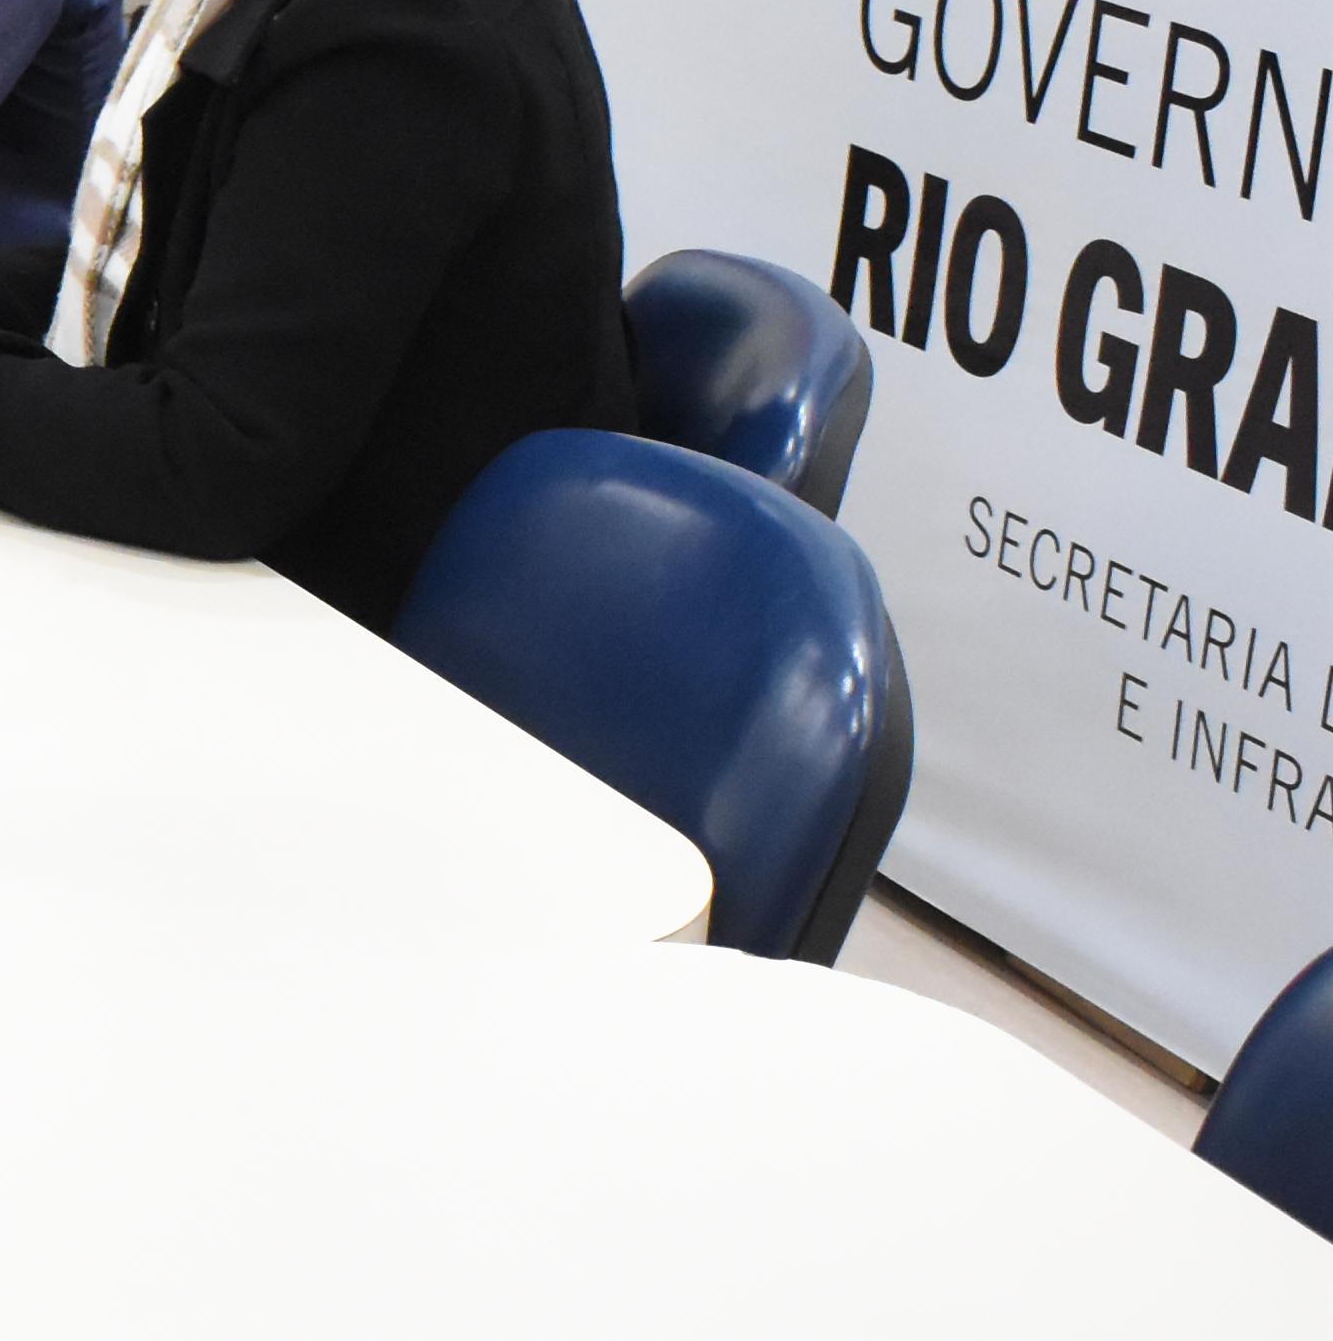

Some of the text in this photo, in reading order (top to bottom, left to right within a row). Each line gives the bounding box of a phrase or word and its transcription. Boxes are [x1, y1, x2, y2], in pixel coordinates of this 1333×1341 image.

[830, 144, 1333, 531] RIO GRA
[965, 496, 1291, 711] SECRETARIA
[1117, 671, 1333, 831] E INFRA
